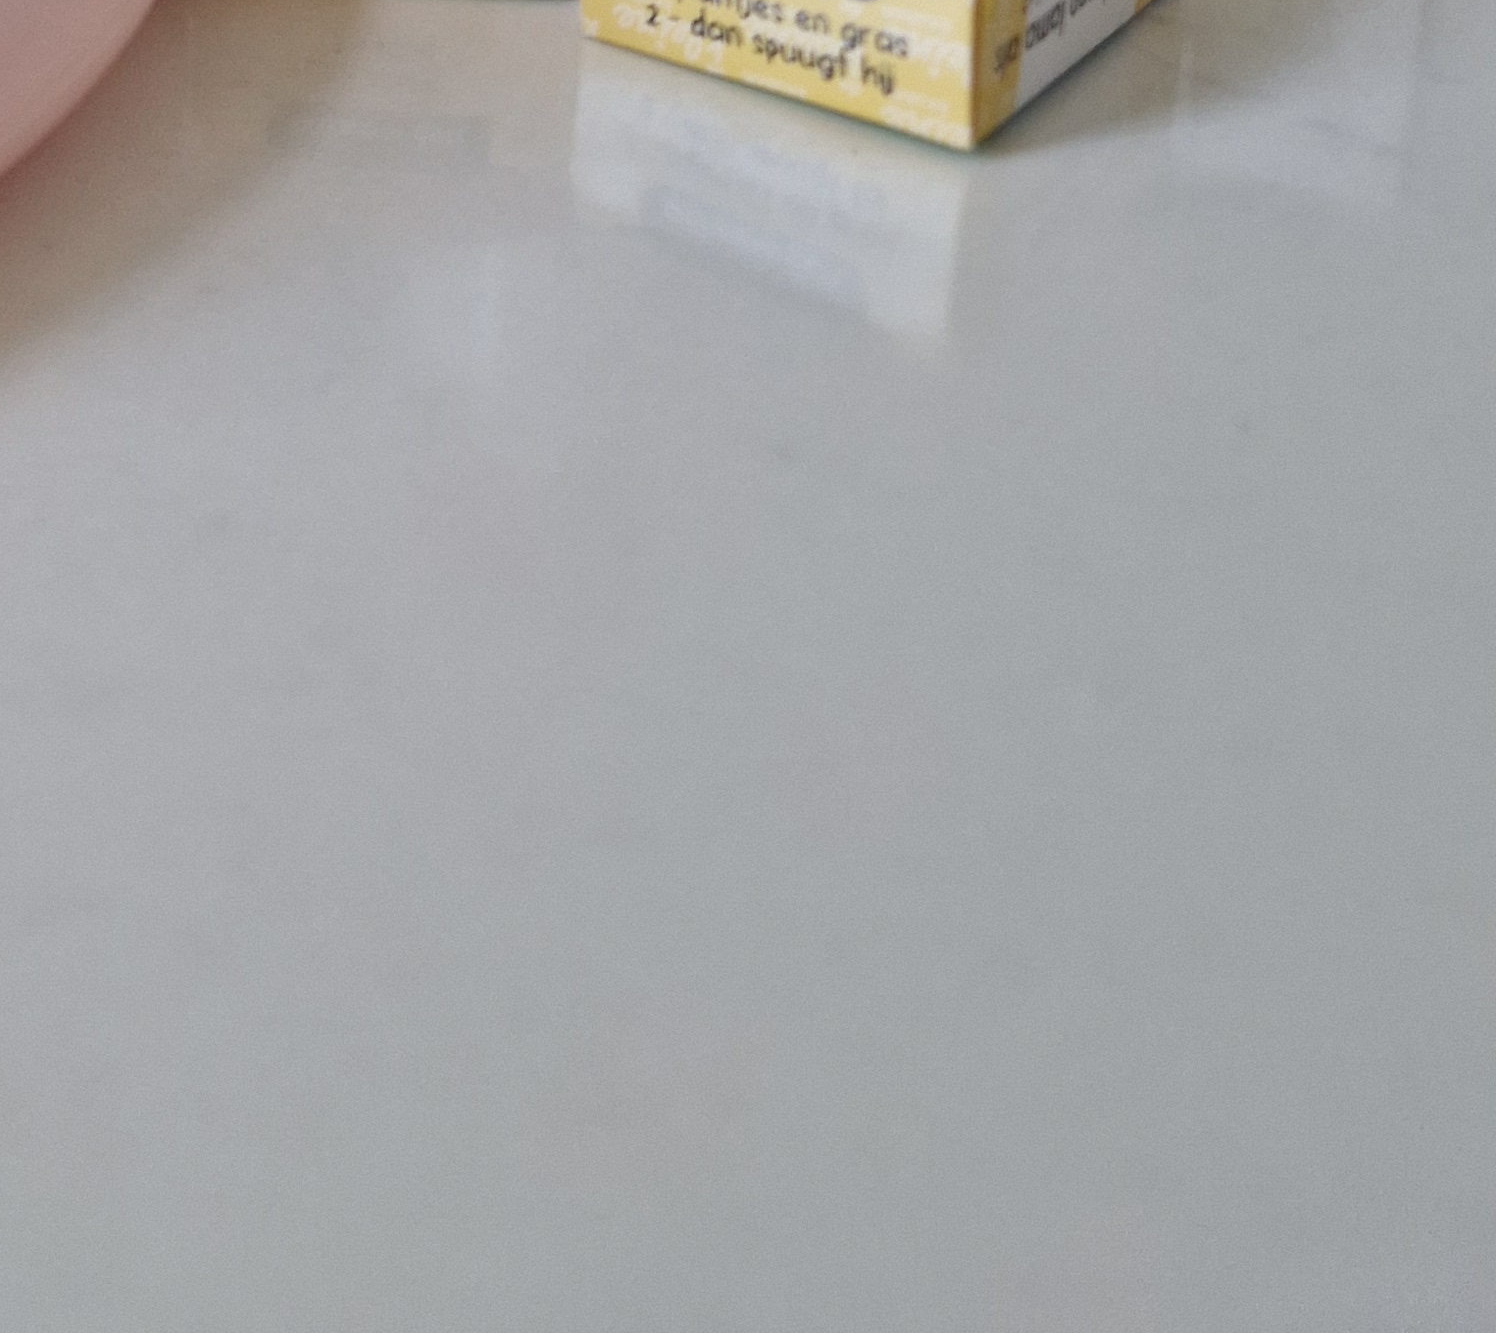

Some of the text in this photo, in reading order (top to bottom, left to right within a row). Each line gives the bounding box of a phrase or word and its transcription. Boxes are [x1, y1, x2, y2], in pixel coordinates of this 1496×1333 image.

[690, 7, 744, 47] dan
[752, 32, 847, 82] spuugt
[794, 6, 828, 33] en
[840, 21, 909, 57] gras
